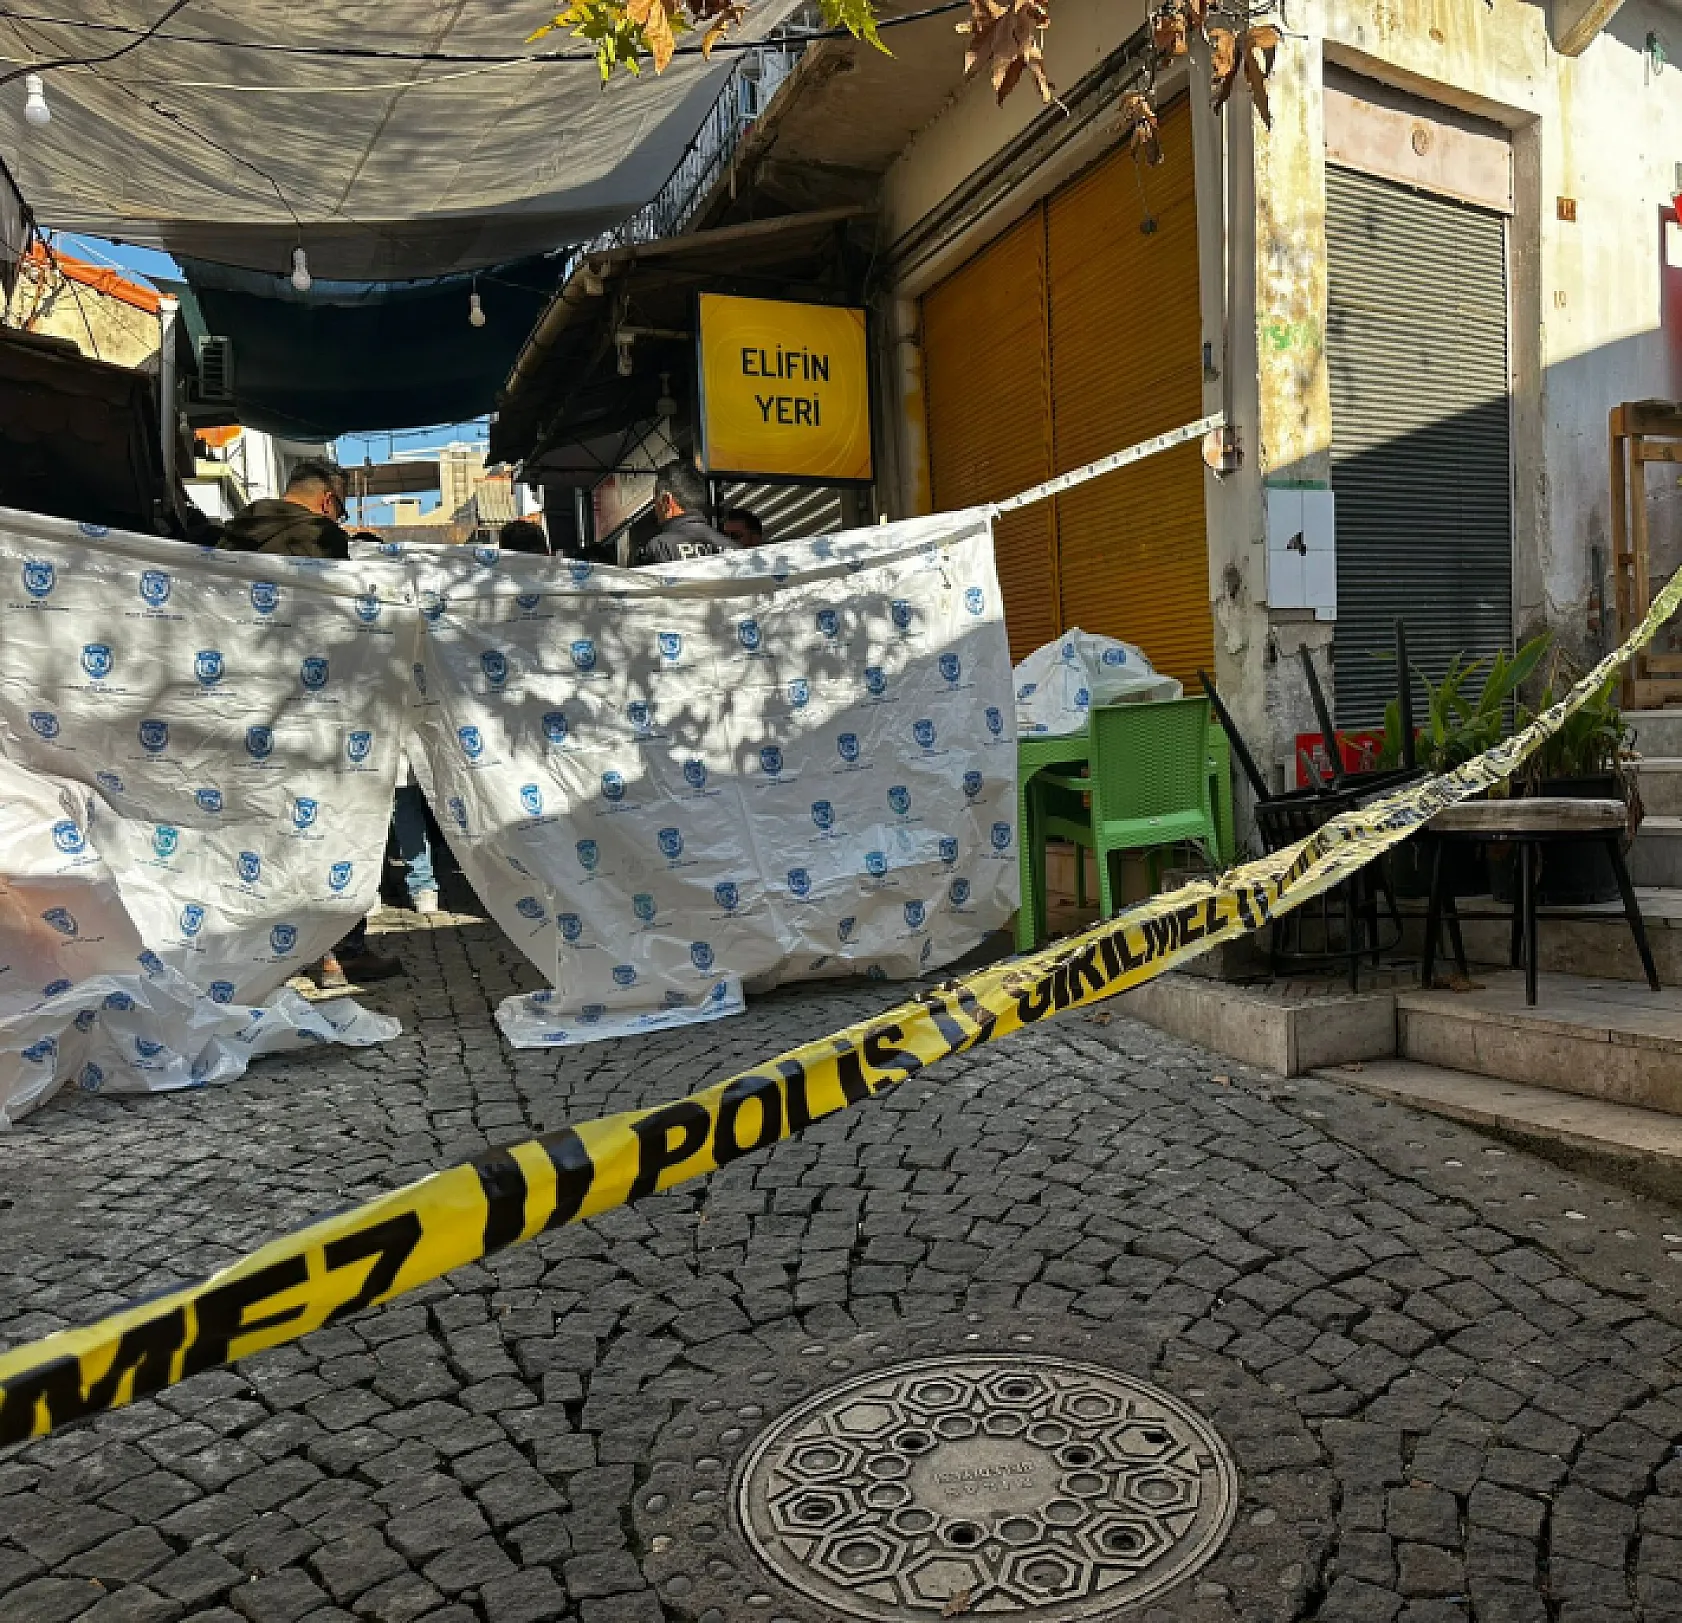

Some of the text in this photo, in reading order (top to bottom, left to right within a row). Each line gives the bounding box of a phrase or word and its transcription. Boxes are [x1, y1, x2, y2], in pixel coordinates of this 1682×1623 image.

[741, 343, 829, 381] ELİFİN
[754, 392, 821, 427] YERİ
[626, 1023, 925, 1206] POLİS
